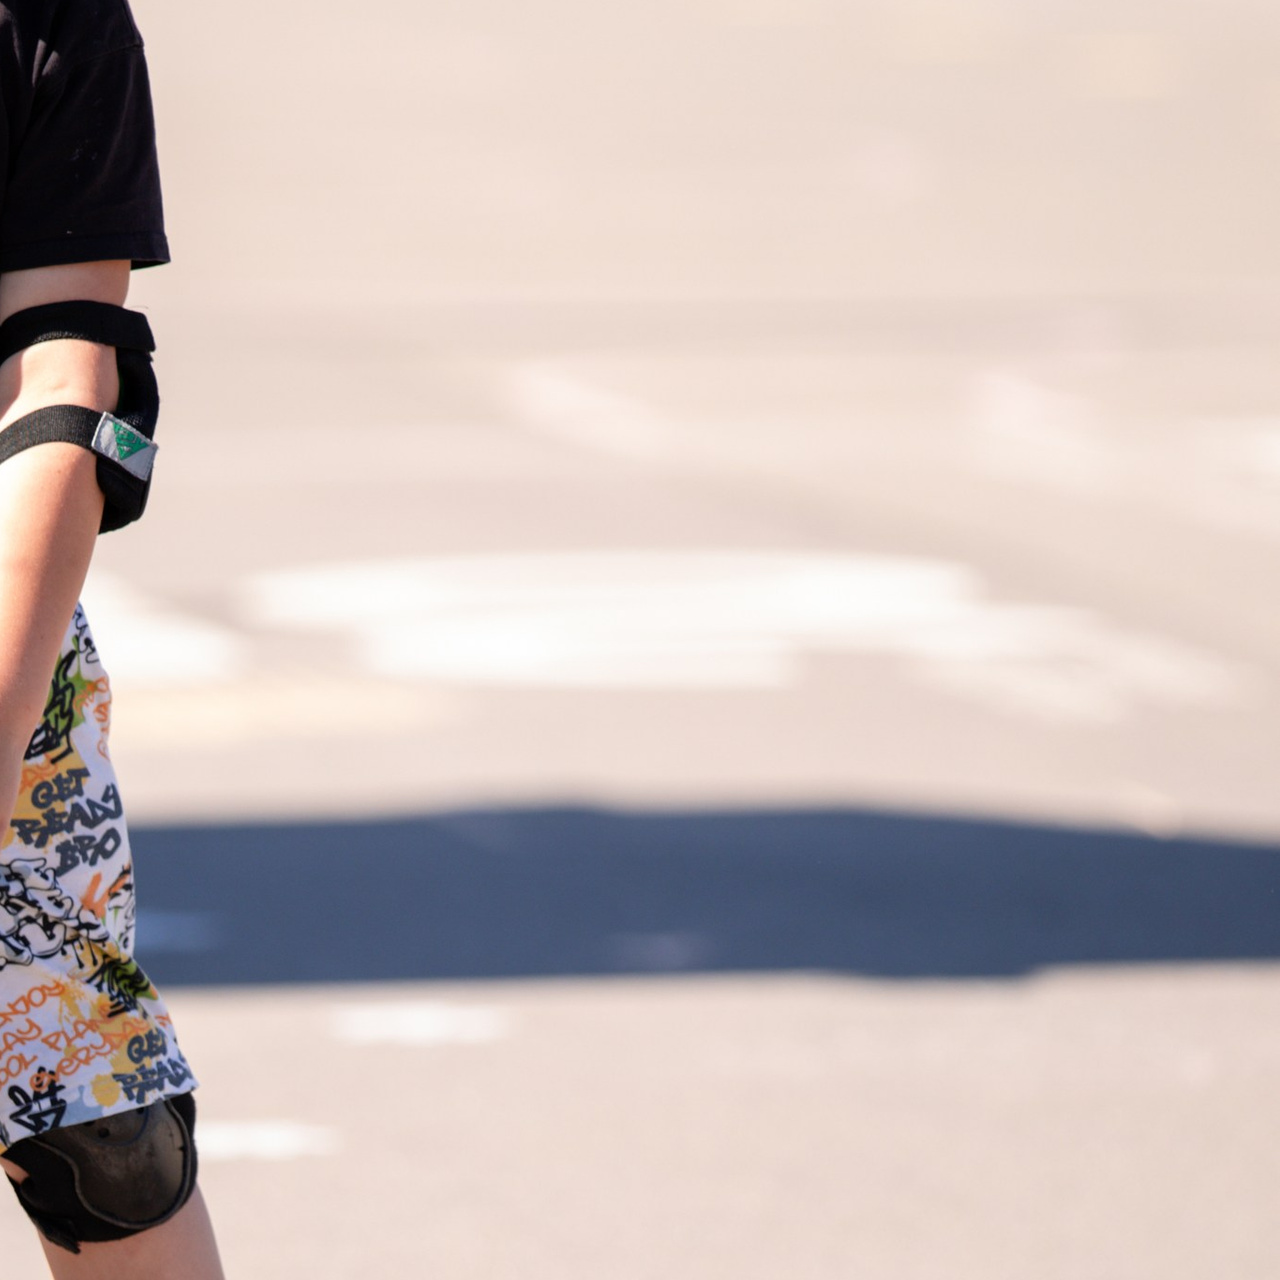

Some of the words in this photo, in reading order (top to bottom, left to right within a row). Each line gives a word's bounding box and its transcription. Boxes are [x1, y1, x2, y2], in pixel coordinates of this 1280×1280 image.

[31, 767, 91, 809] GET
[10, 782, 123, 849] READY
[55, 827, 122, 877] BRO
